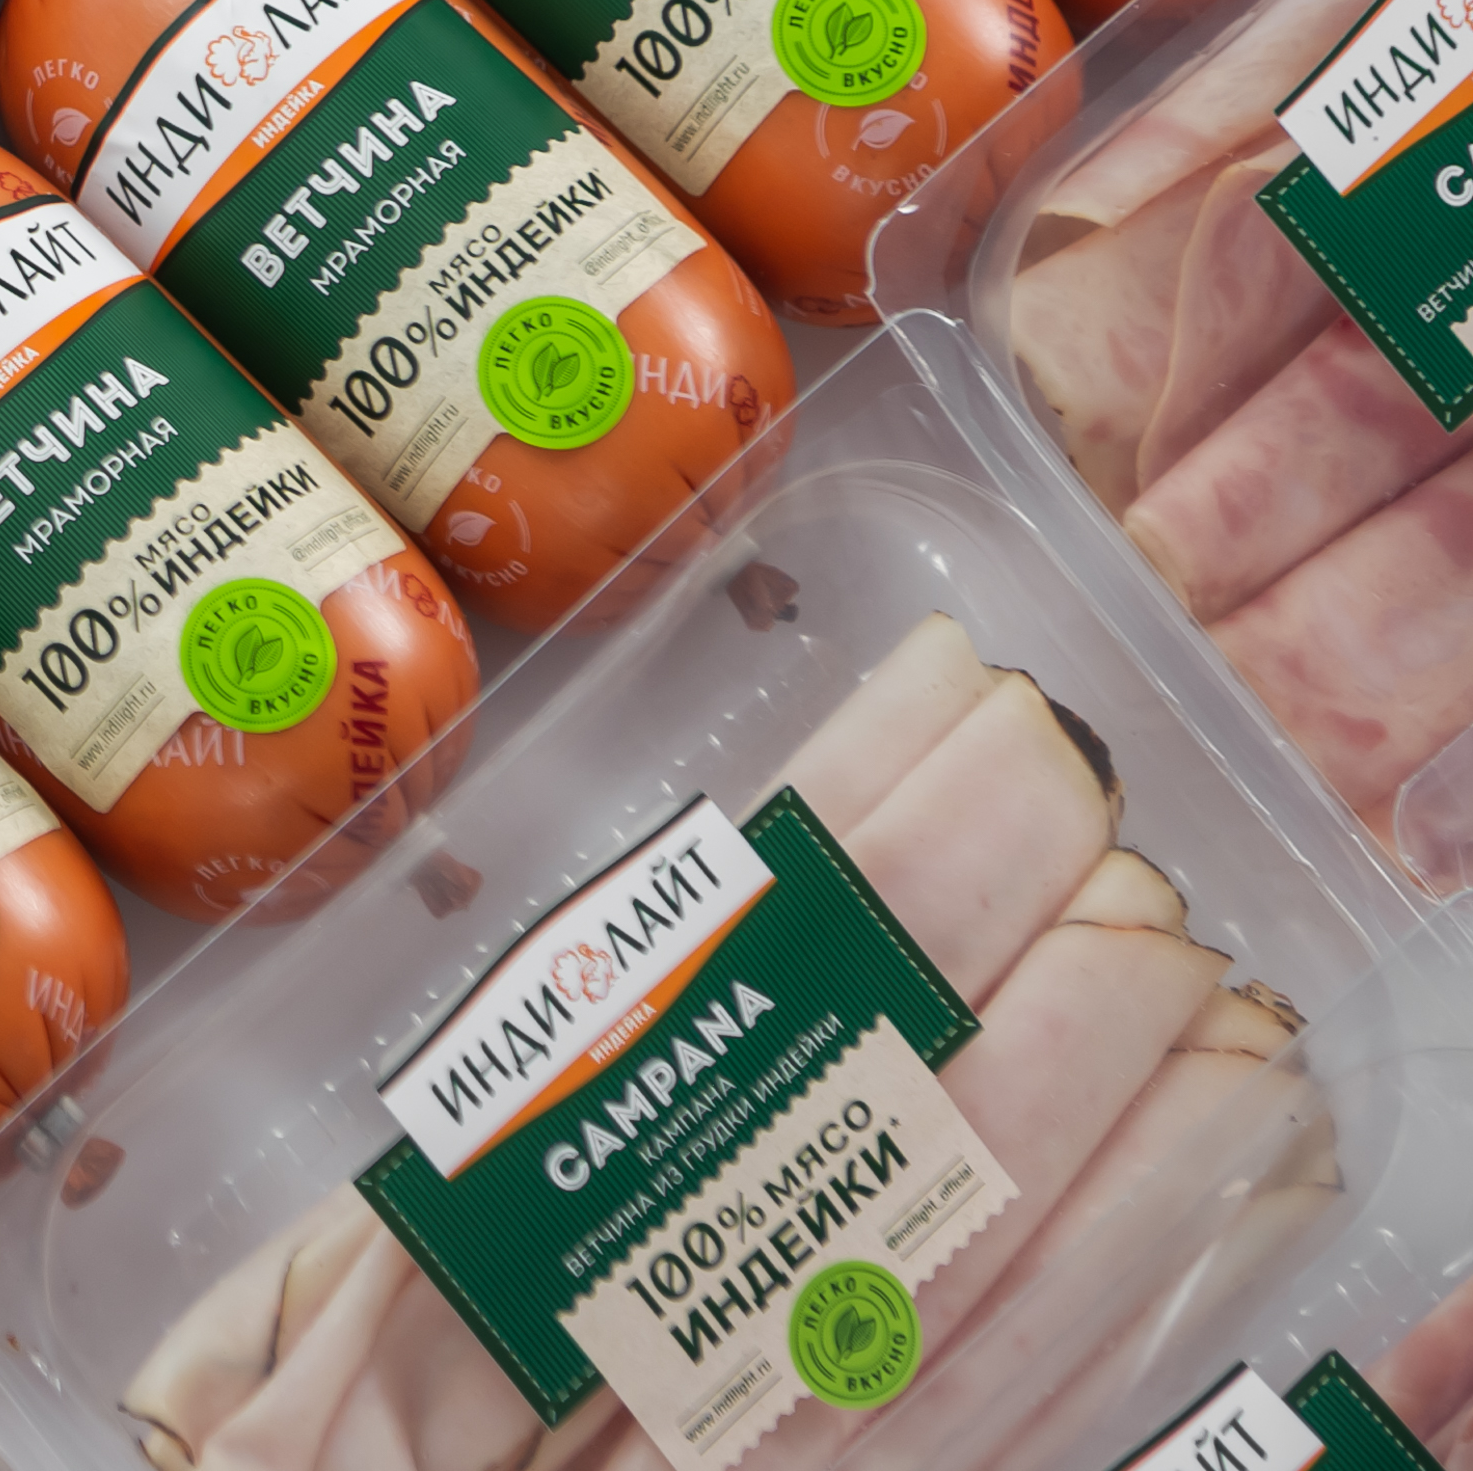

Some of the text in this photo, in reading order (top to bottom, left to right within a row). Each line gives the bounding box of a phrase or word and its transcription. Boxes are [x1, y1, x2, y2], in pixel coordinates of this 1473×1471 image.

[241, 80, 457, 288] ВЕТЧИНА
[311, 140, 466, 296] МРАМОРНАЯ
[446, 170, 614, 322] ИНДЕЙКИ
[329, 304, 458, 439] 100%
[13, 416, 179, 564] МРАМОРНАЯ
[154, 460, 319, 598] ИНДЕЙКИ
[22, 580, 161, 714] 100%
[589, 1003, 658, 1064] ИНДЕЙКА
[566, 1013, 844, 1279] ВЕТЧИНА ИЗ ГРУДКИ ИНДЕЙКИ
[639, 1075, 736, 1166] КАМПАНА
[626, 1098, 873, 1321] 100% МЯСО
[806, 1275, 858, 1328] ЛЕГКО
[847, 1330, 907, 1392] ВКУСНО
